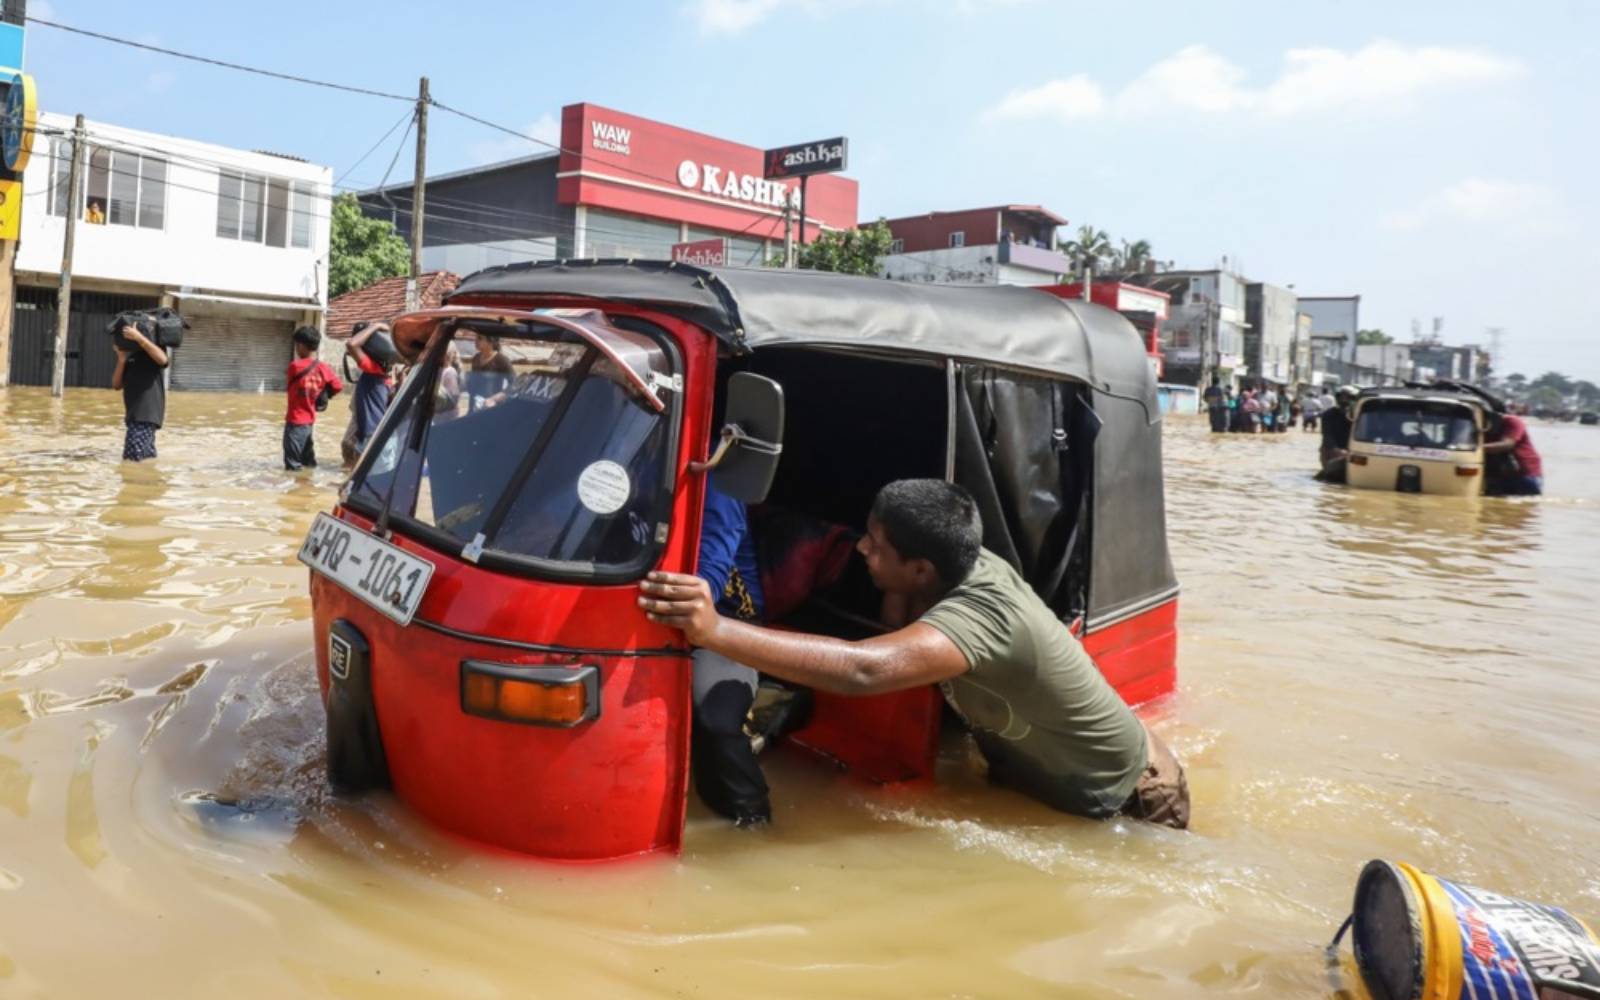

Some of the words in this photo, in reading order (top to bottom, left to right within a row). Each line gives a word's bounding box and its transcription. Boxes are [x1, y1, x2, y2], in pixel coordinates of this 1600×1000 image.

[592, 120, 631, 145] WAW
[593, 139, 631, 155] BUILDING
[702, 164, 802, 211] KASHKA
